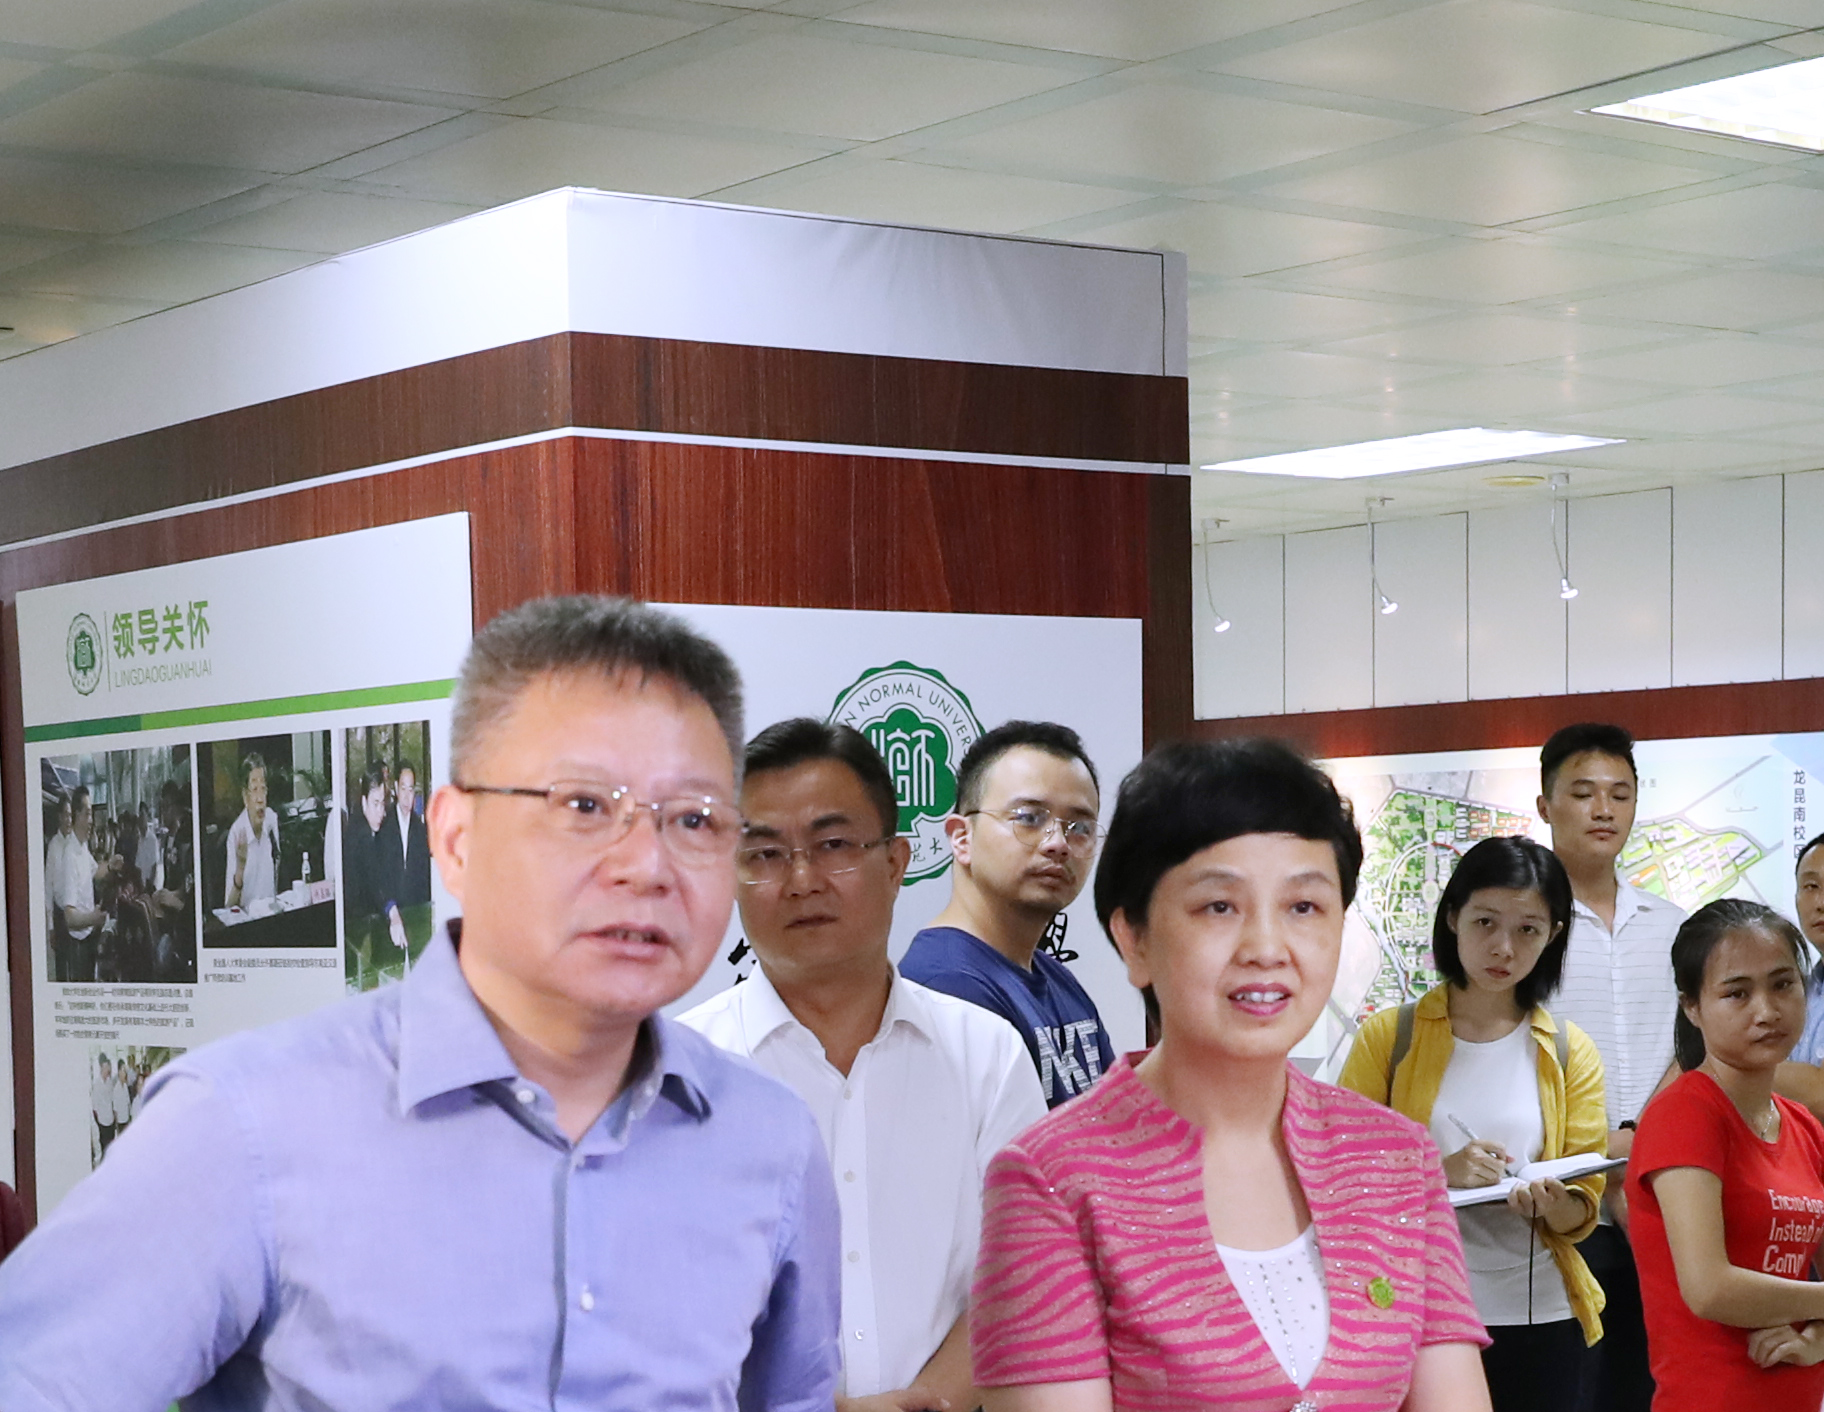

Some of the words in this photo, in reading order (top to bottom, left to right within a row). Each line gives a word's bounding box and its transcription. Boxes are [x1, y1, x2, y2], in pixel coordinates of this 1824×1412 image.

[112, 600, 211, 660] 领导关怀
[114, 659, 212, 689] LINGDAOGUANHUAI
[858, 682, 923, 712] NORMAL
[1792, 770, 1807, 859] 龙昆南校区
[1768, 1188, 1824, 1219] Encourage
[1768, 1217, 1815, 1243] Instead
